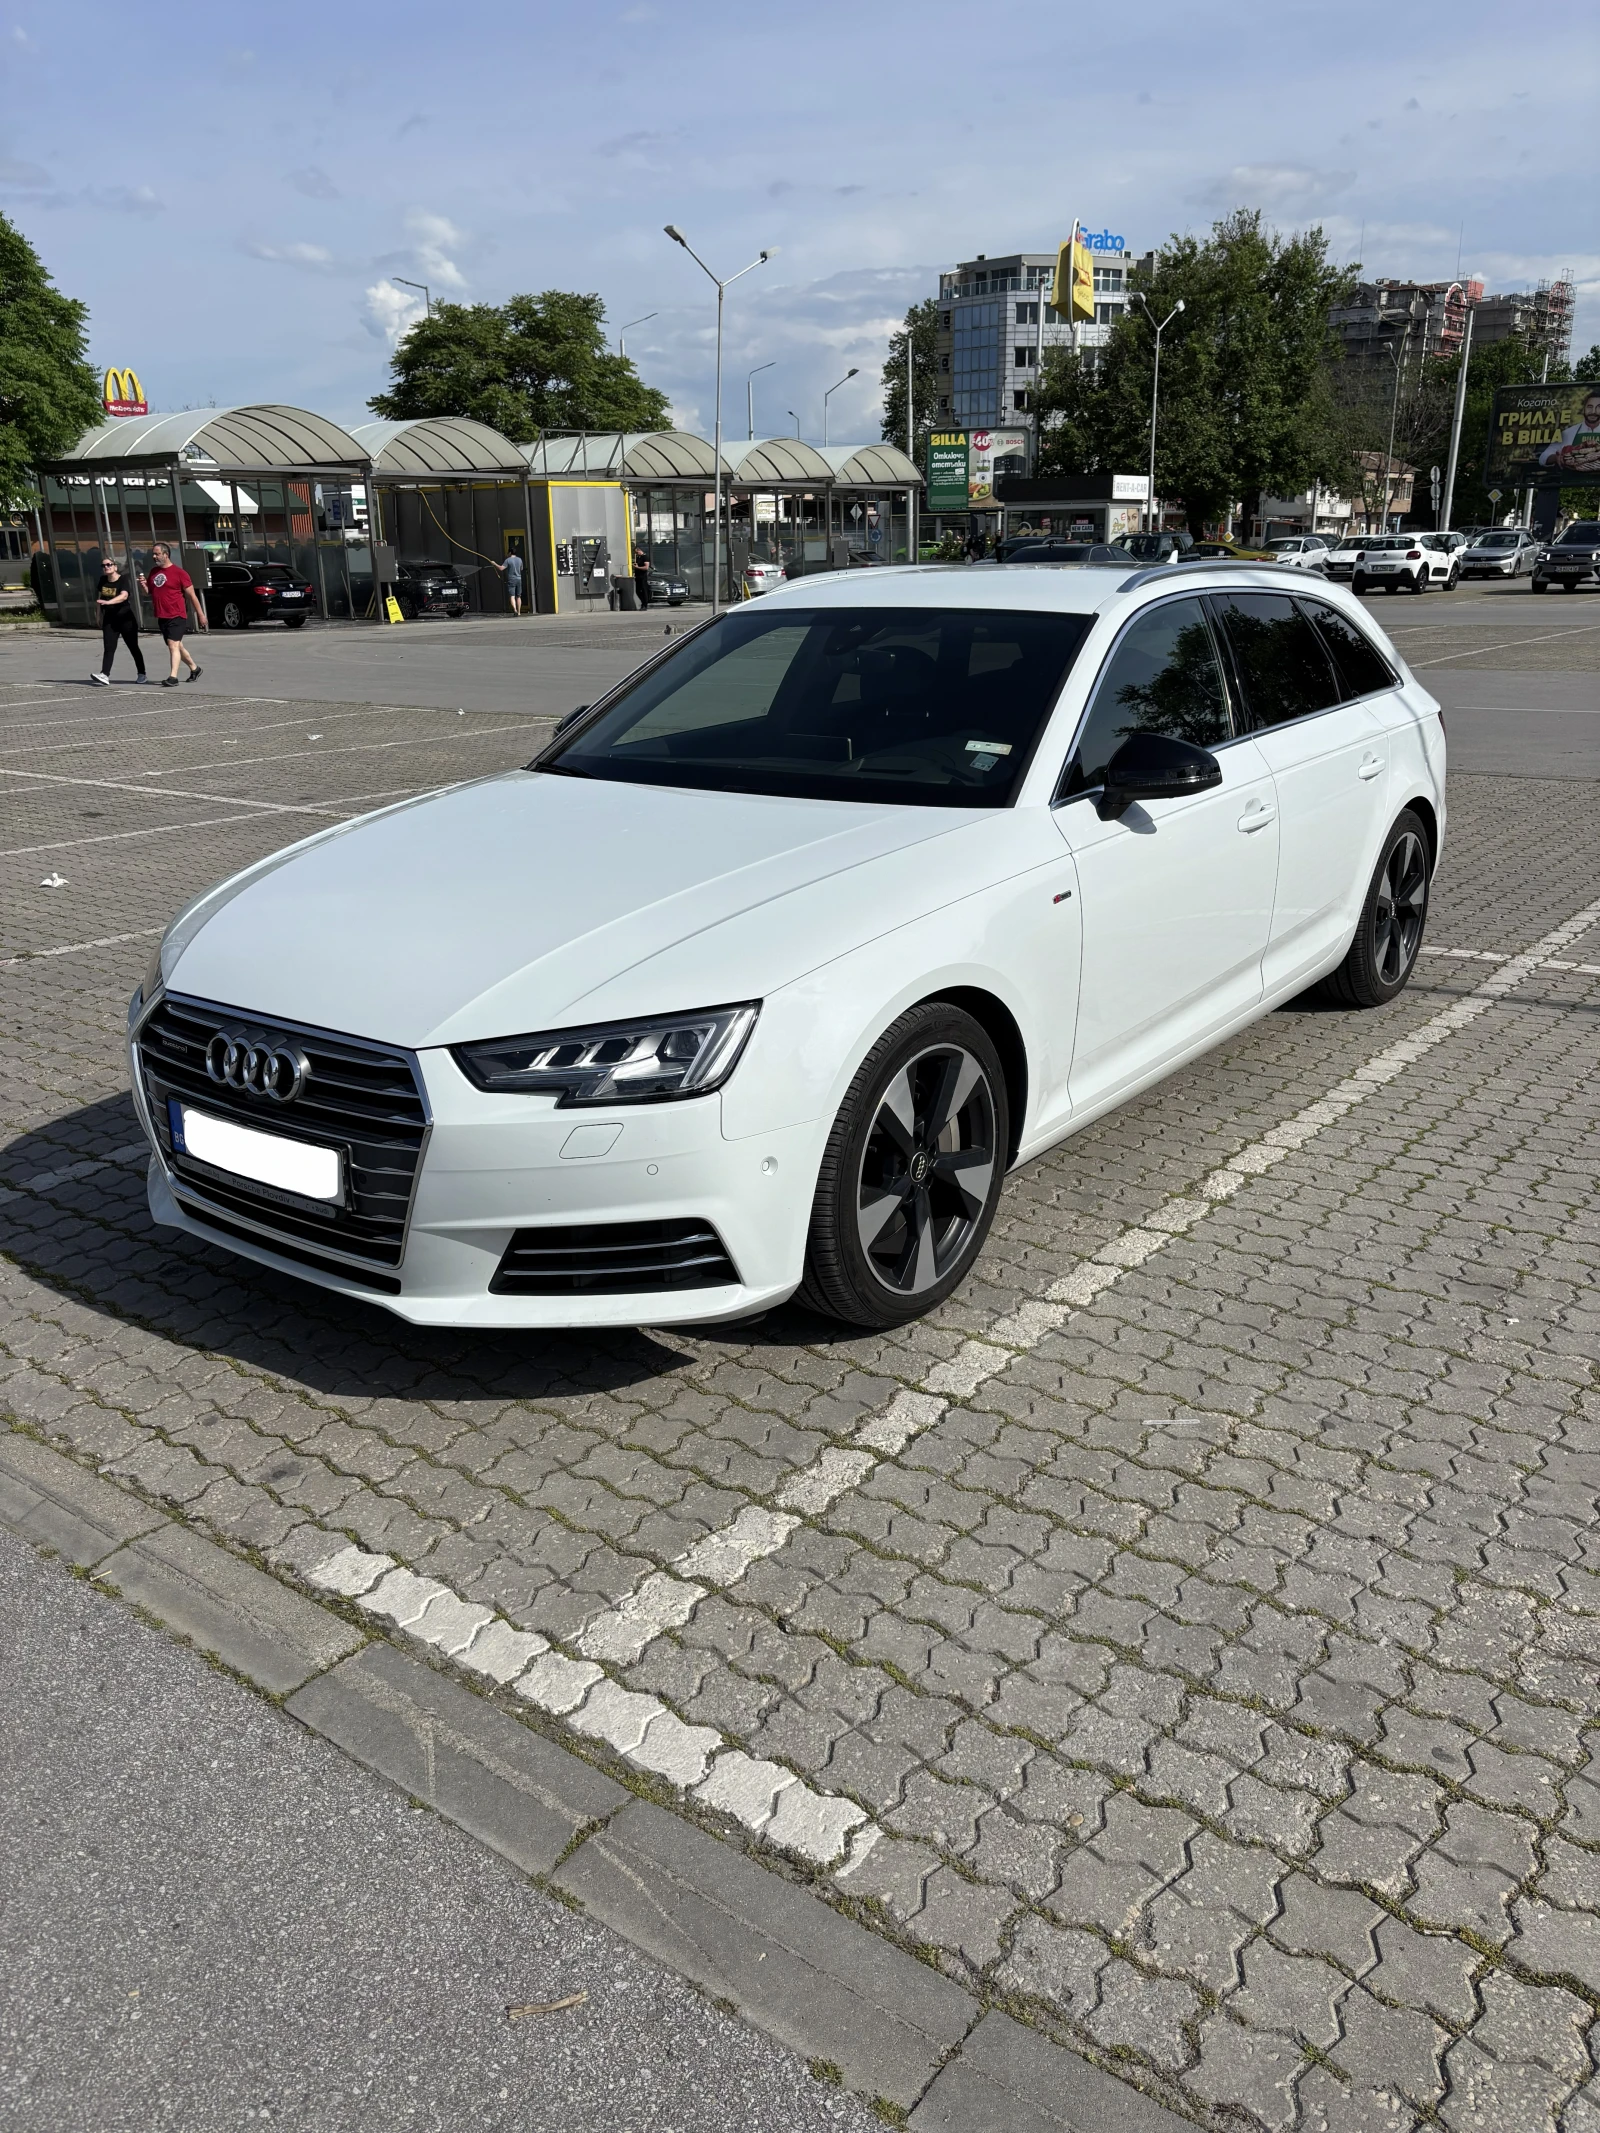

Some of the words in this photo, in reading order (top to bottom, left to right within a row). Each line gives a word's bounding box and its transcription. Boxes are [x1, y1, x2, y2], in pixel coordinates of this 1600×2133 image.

[1517, 399, 1557, 408] Когато
[1499, 411, 1556, 426] ГРИЛА
[931, 433, 966, 446] BILLA
[1518, 429, 1563, 445] BILLA
[1115, 481, 1148, 493] RENT-A-CAR
[174, 1131, 185, 1145] BG
[231, 1177, 261, 1194] Porsche
[261, 1188, 291, 1204] Plovdiv
